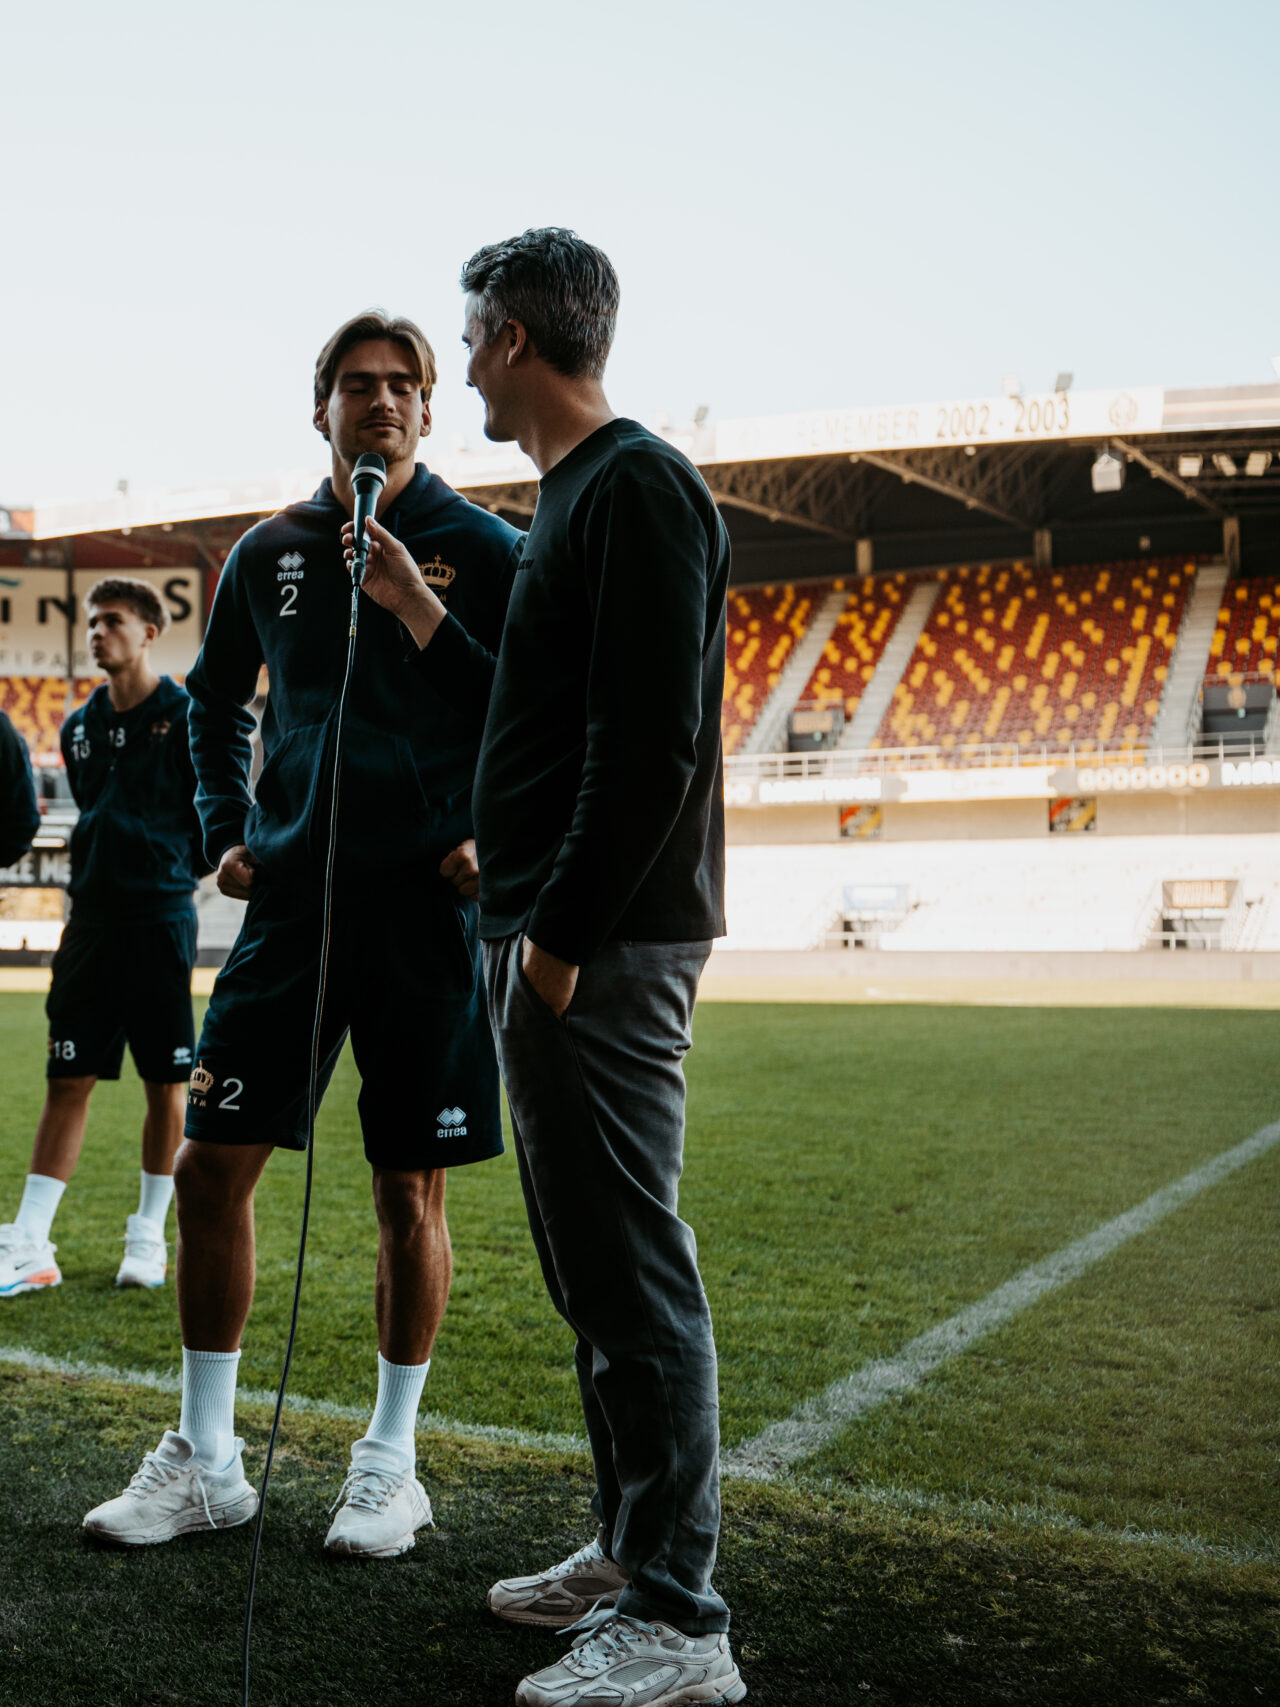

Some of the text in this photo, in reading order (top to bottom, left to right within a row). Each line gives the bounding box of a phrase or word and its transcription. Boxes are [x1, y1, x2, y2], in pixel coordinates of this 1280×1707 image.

[936, 402, 990, 439] 2002
[1010, 395, 1069, 435] 2003
[278, 583, 299, 617] 2
[70, 739, 91, 762] 18
[108, 727, 126, 749] 18
[55, 1039, 77, 1061] 18
[218, 1076, 244, 1111] 2
